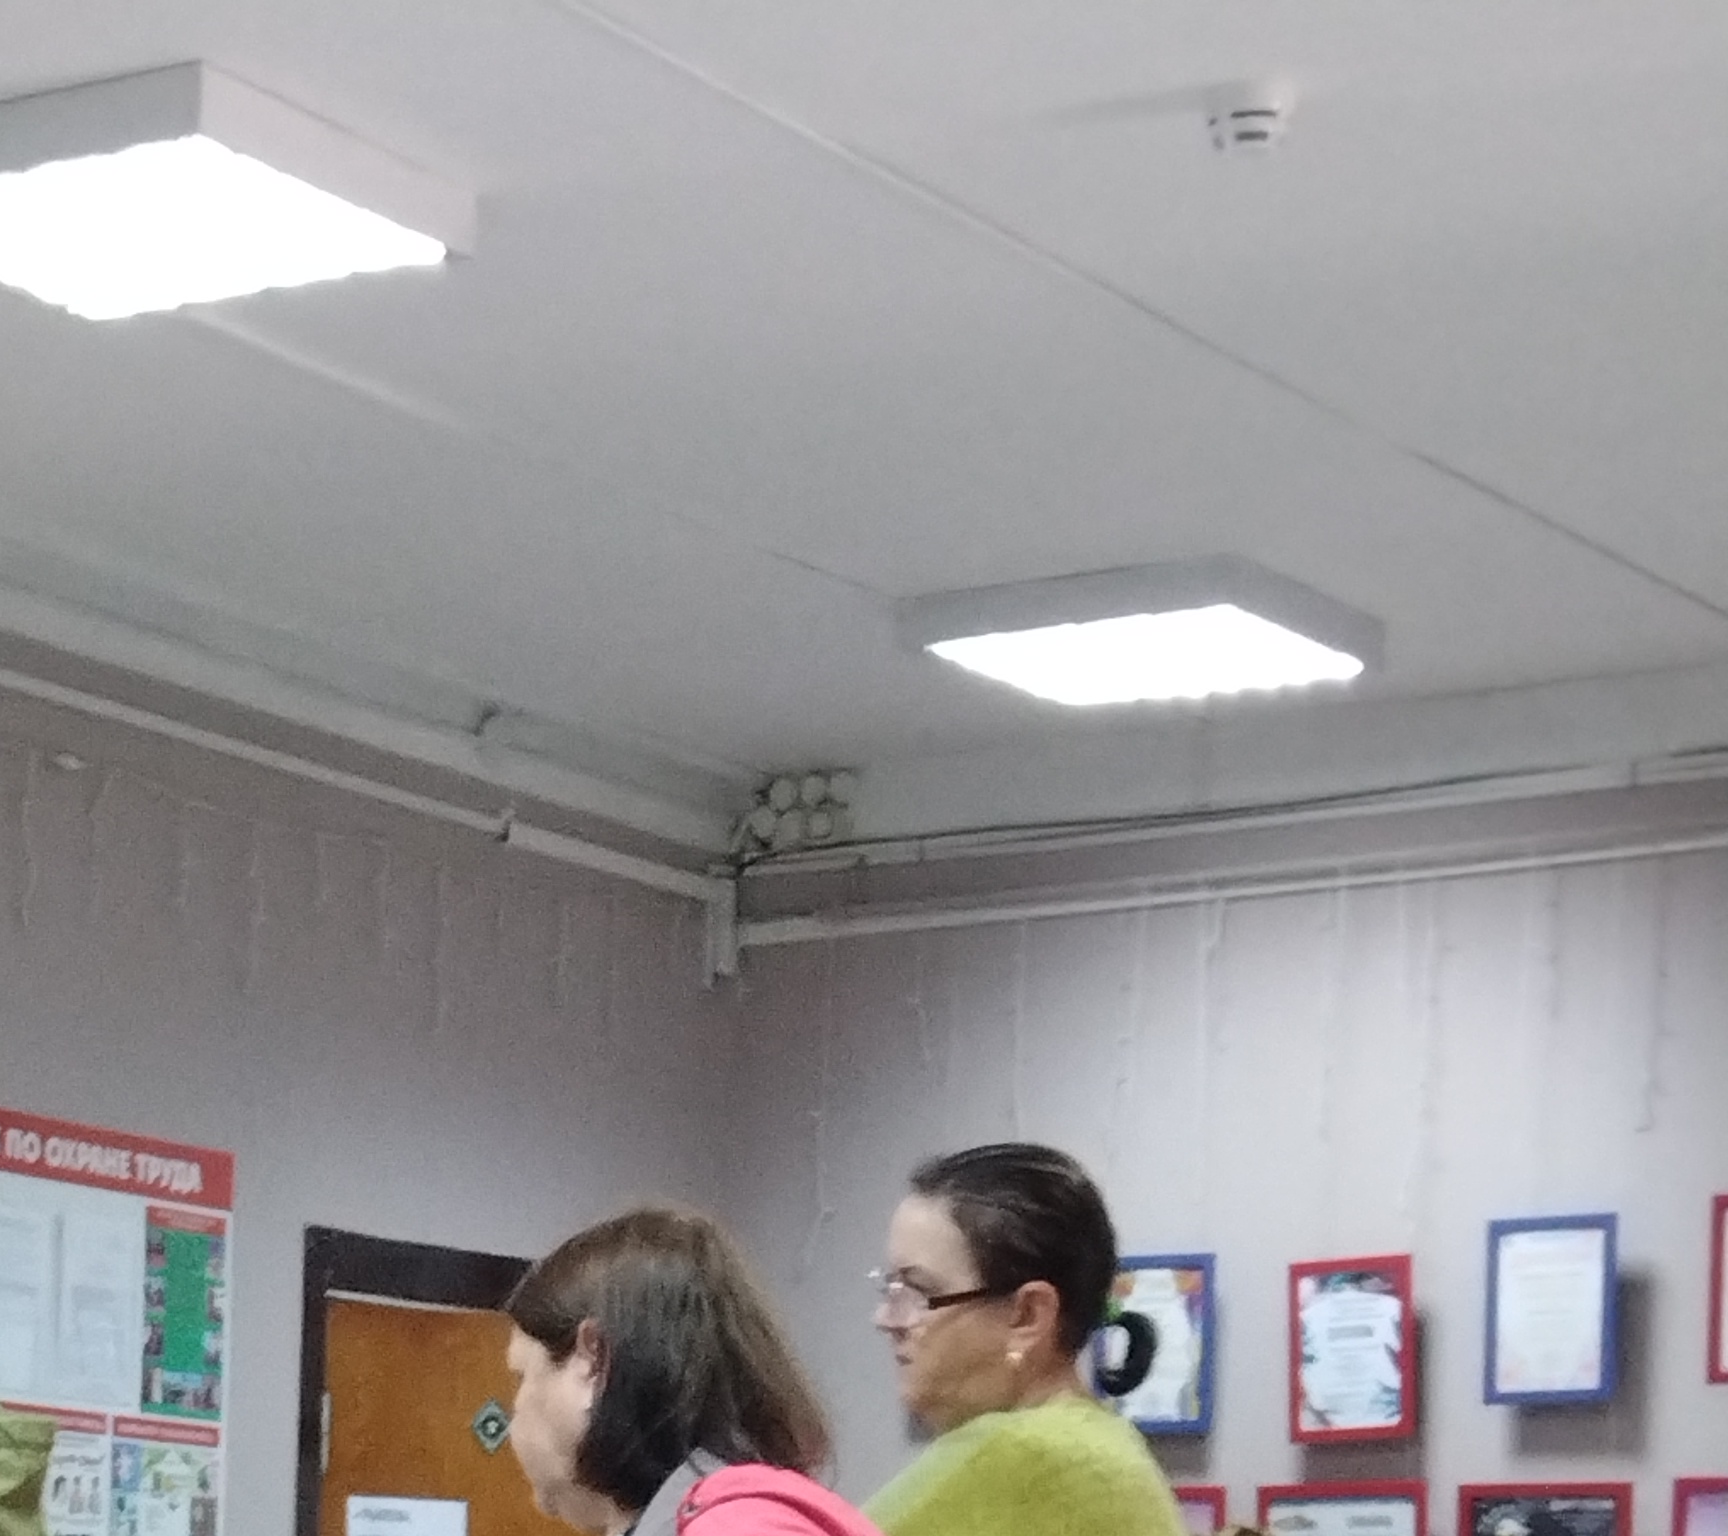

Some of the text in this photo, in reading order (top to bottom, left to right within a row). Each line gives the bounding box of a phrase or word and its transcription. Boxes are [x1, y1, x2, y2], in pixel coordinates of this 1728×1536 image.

[3, 1127, 42, 1163] ПО
[44, 1136, 132, 1180] ОХРАНЕ
[133, 1152, 204, 1195] ТРУДА
